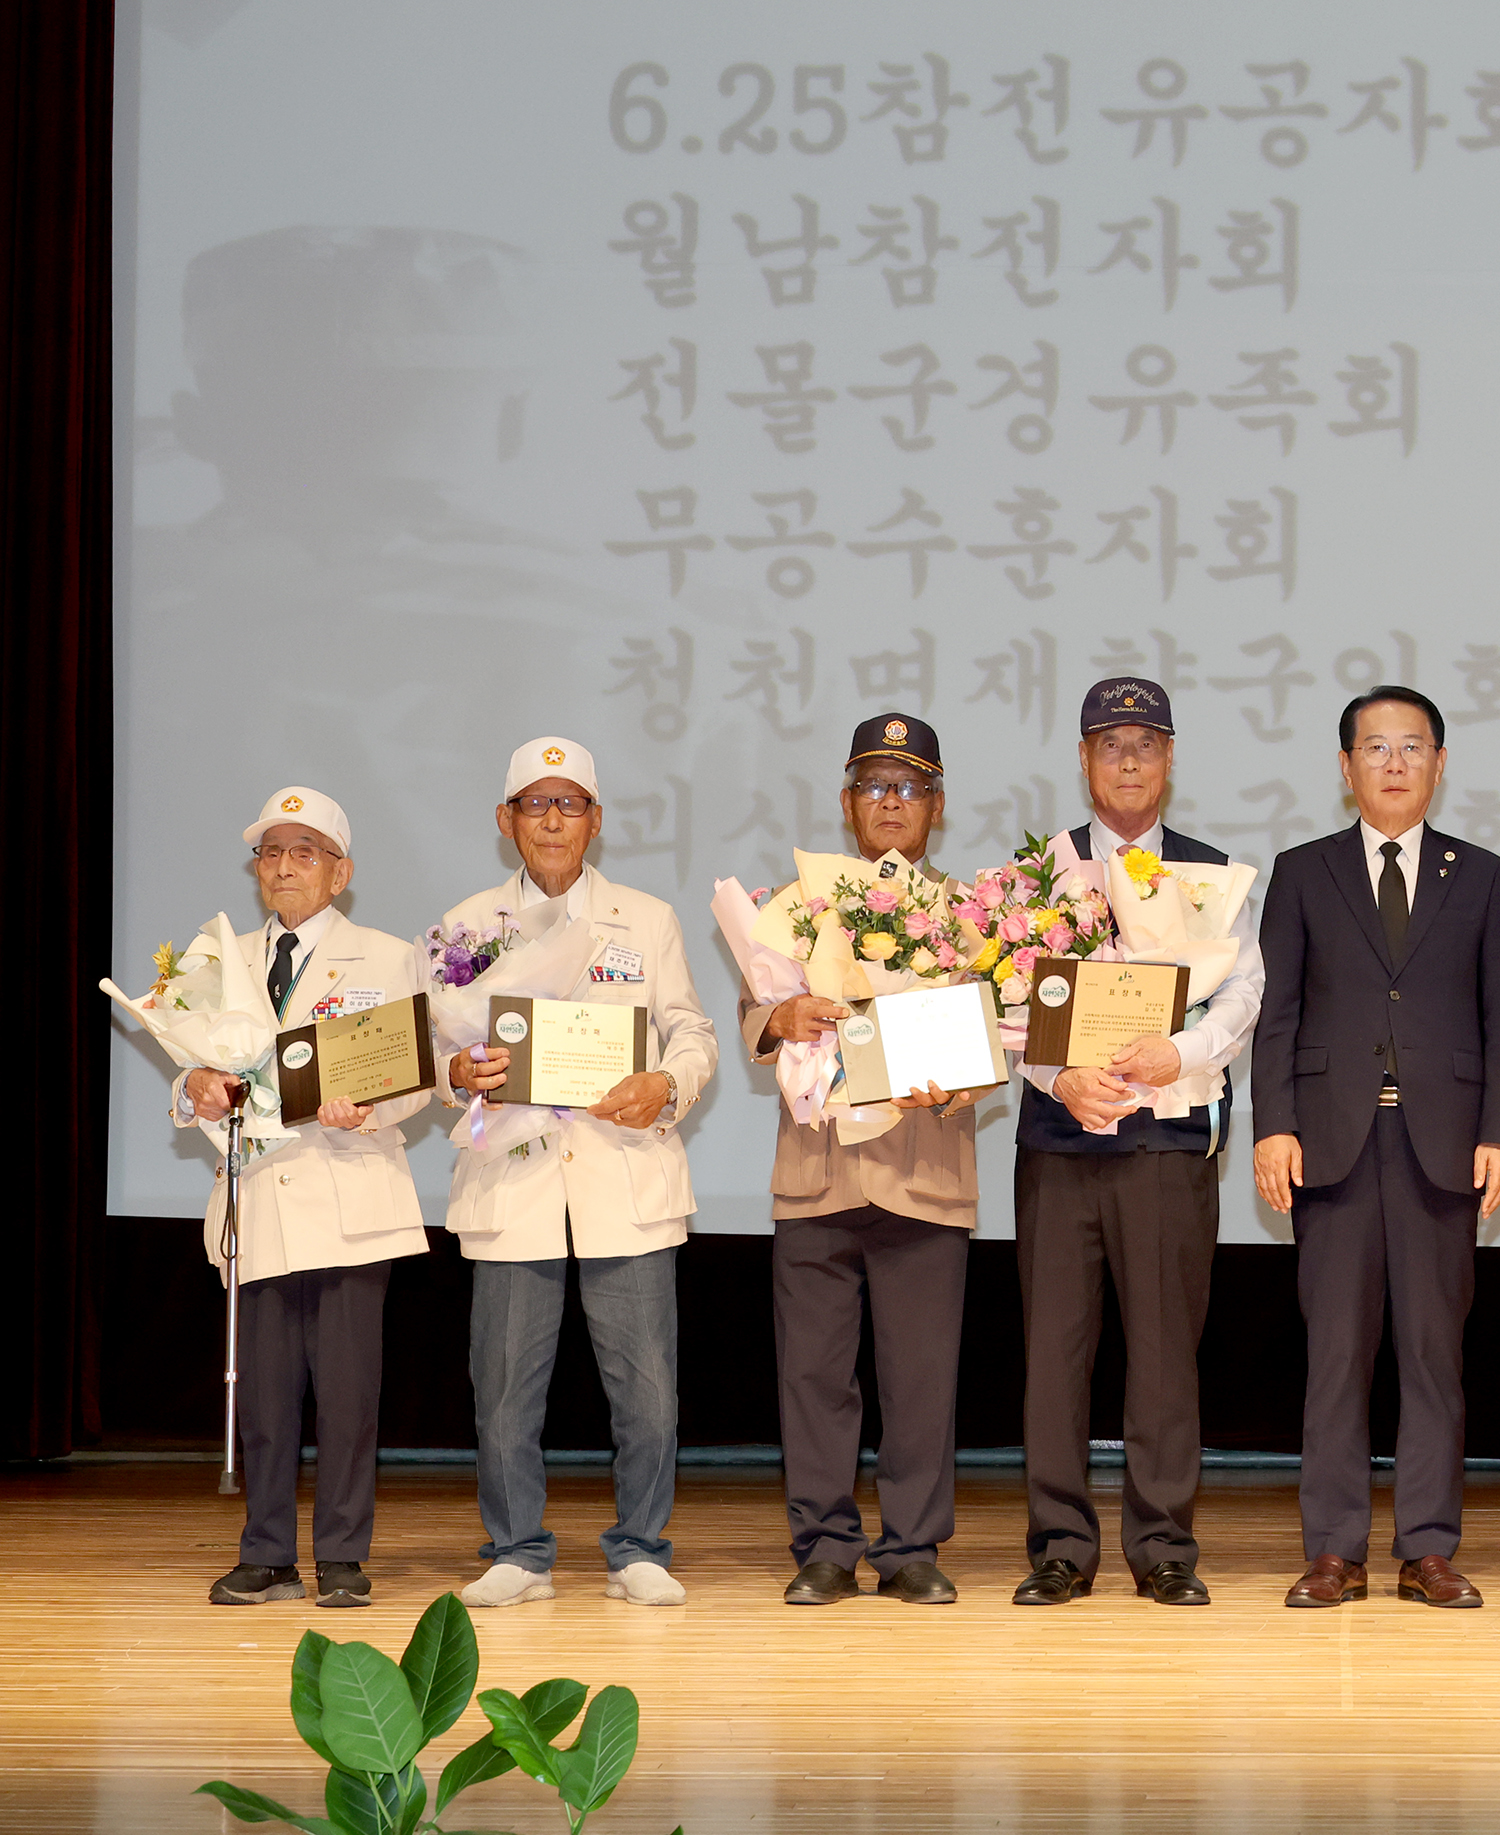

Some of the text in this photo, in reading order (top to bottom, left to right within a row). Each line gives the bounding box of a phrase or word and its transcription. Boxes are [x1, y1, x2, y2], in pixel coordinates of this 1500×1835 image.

[606, 190, 1299, 311] 월남참전자회
[607, 335, 1418, 456] 전몰군경유족회
[602, 484, 1297, 600] 무공수훈자회
